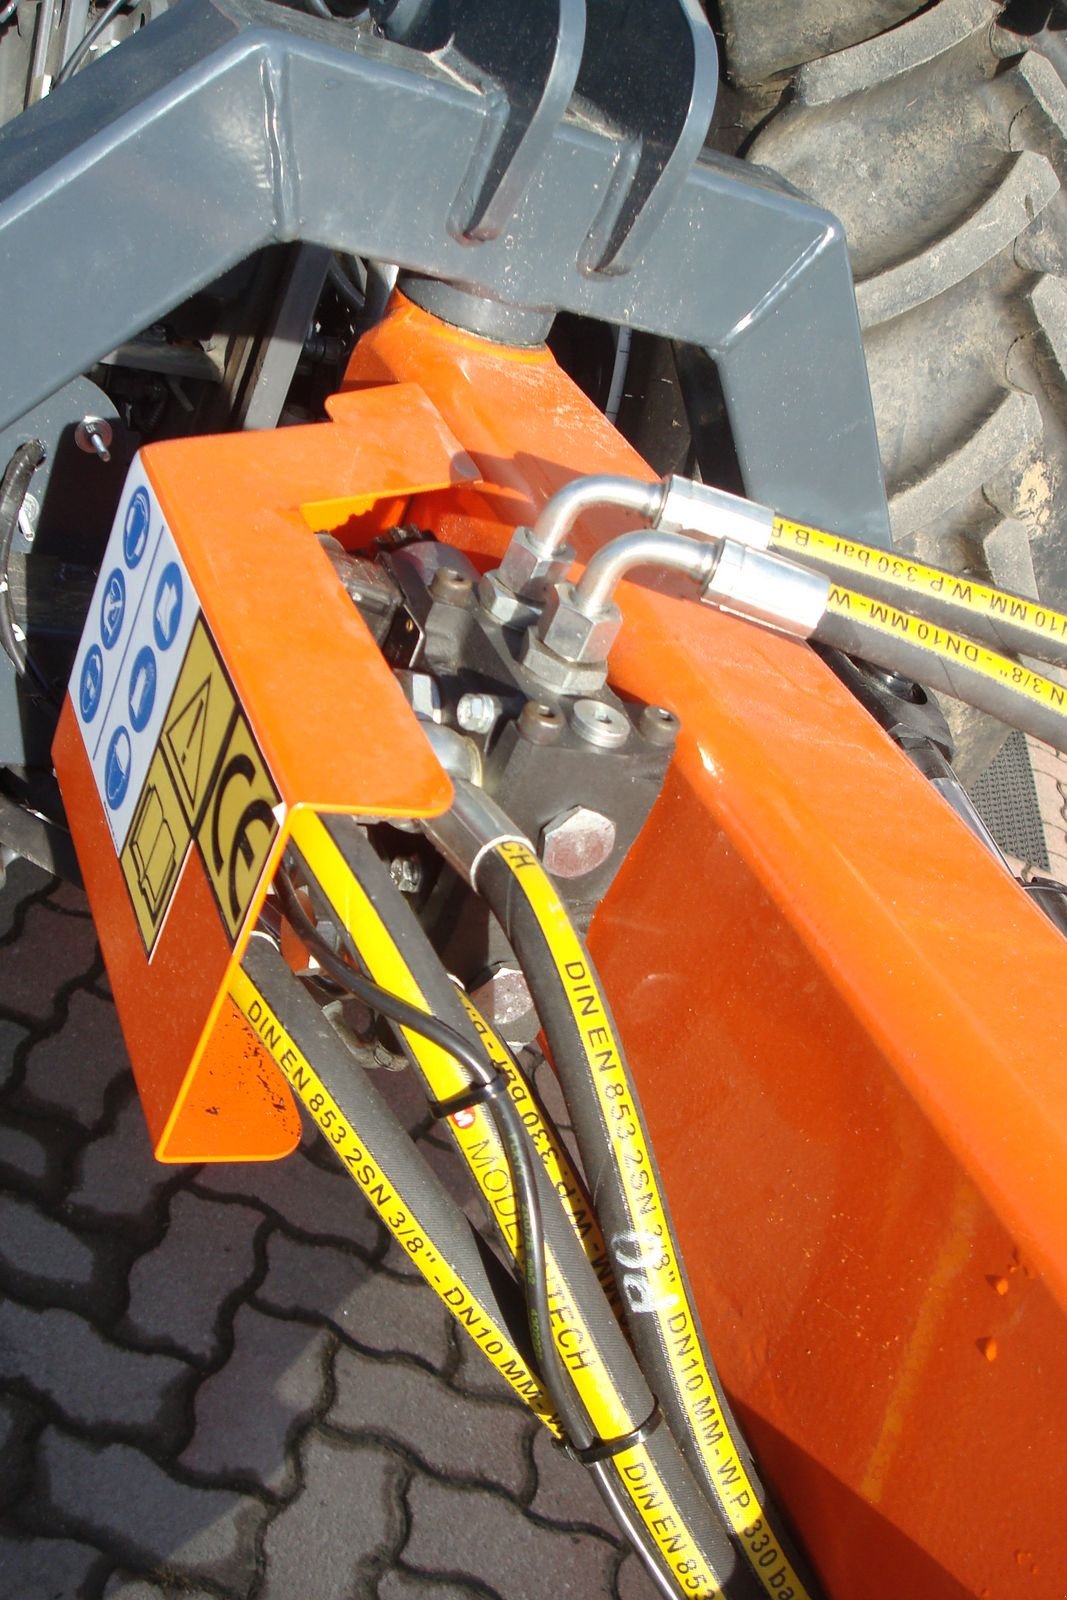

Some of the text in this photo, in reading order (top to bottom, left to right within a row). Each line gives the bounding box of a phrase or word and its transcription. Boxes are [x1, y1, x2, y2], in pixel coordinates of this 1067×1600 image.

[836, 541, 871, 567] bar
[878, 556, 918, 582] 330
[917, 623, 979, 662] DN10
[211, 753, 276, 925] CE
[521, 1111, 558, 1164] 330
[247, 1000, 282, 1047] DIN
[279, 1048, 311, 1092] EN
[308, 1093, 347, 1146] 853
[344, 1147, 392, 1207] 2SN
[388, 1211, 436, 1264] 3/8"
[443, 1286, 504, 1356] DN10
[564, 960, 599, 1017] DIN
[588, 1026, 617, 1073] EN
[605, 1083, 636, 1139] 853
[622, 1149, 657, 1216] 2SN
[667, 1311, 704, 1392] DN10
[743, 1518, 778, 1567] 330
[624, 1462, 664, 1510] DIN
[652, 1516, 688, 1554] EN
